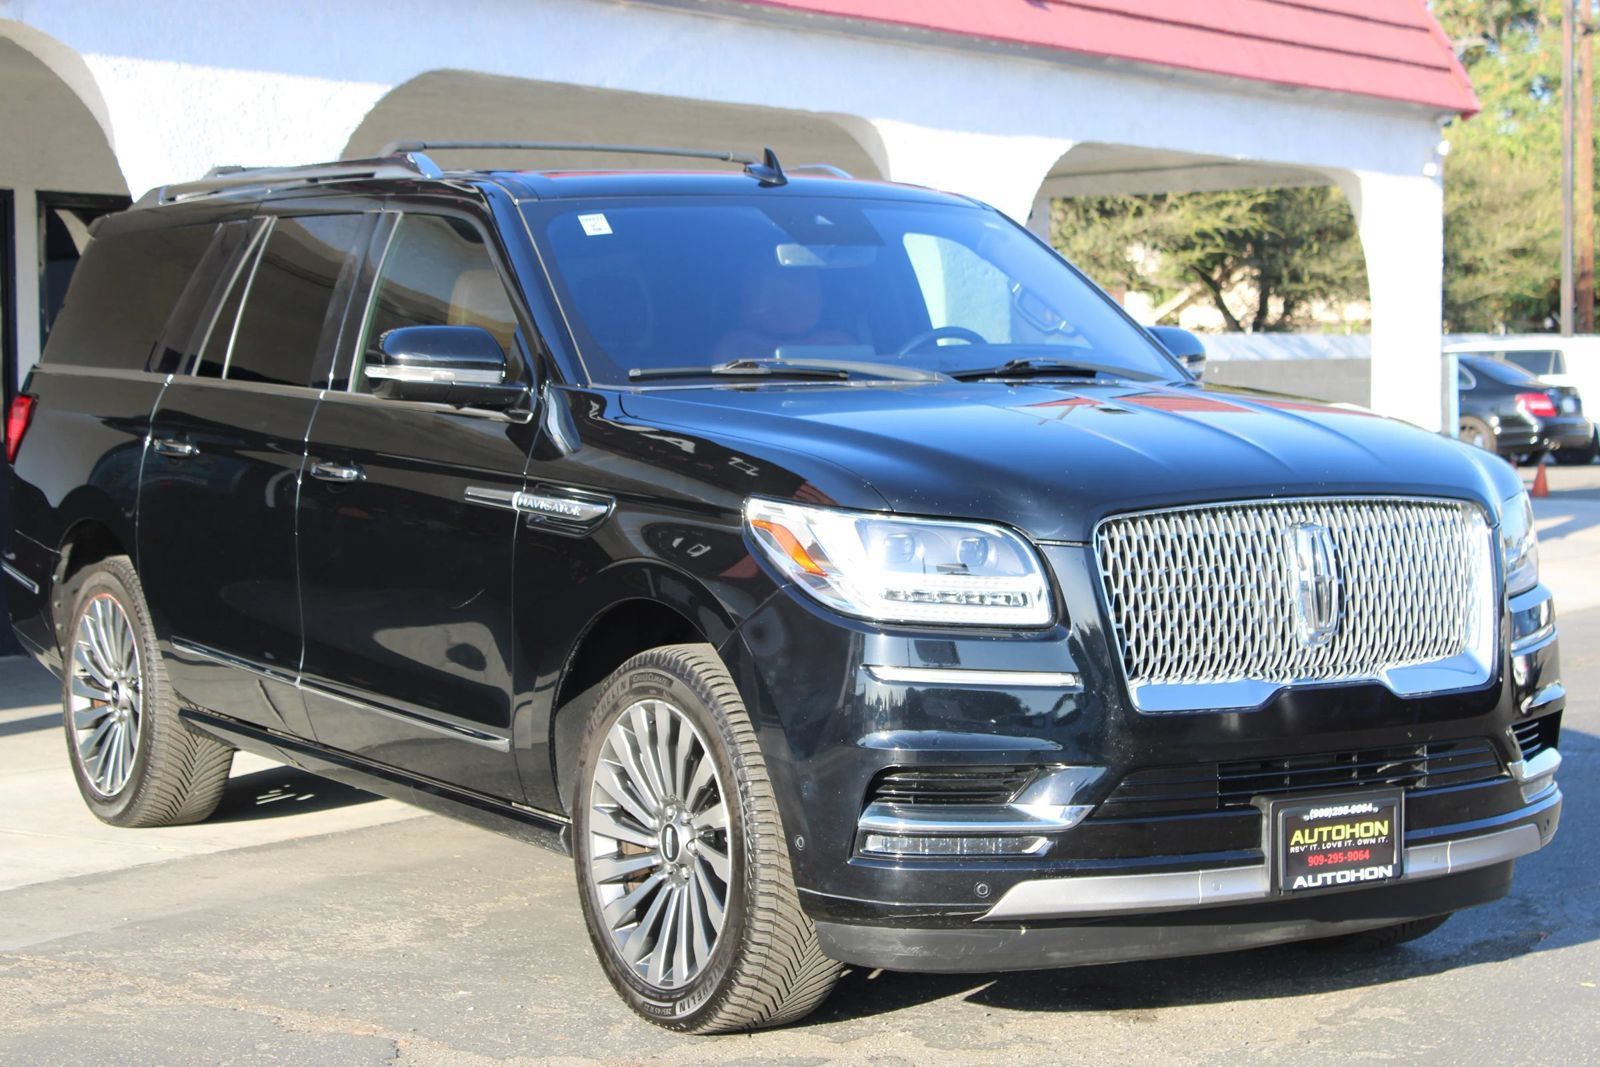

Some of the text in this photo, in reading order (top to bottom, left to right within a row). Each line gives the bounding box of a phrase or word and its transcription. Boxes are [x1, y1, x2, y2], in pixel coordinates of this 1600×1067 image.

[518, 496, 581, 516] NAVIGATOR
[1290, 820, 1389, 846] AUTOHON
[1322, 842, 1343, 850] LOVE
[1357, 838, 1376, 846] OWN
[1307, 849, 1371, 867] 909-295-9064
[1292, 864, 1393, 890] AUTOHON
[679, 954, 726, 1013] MICHELIN
